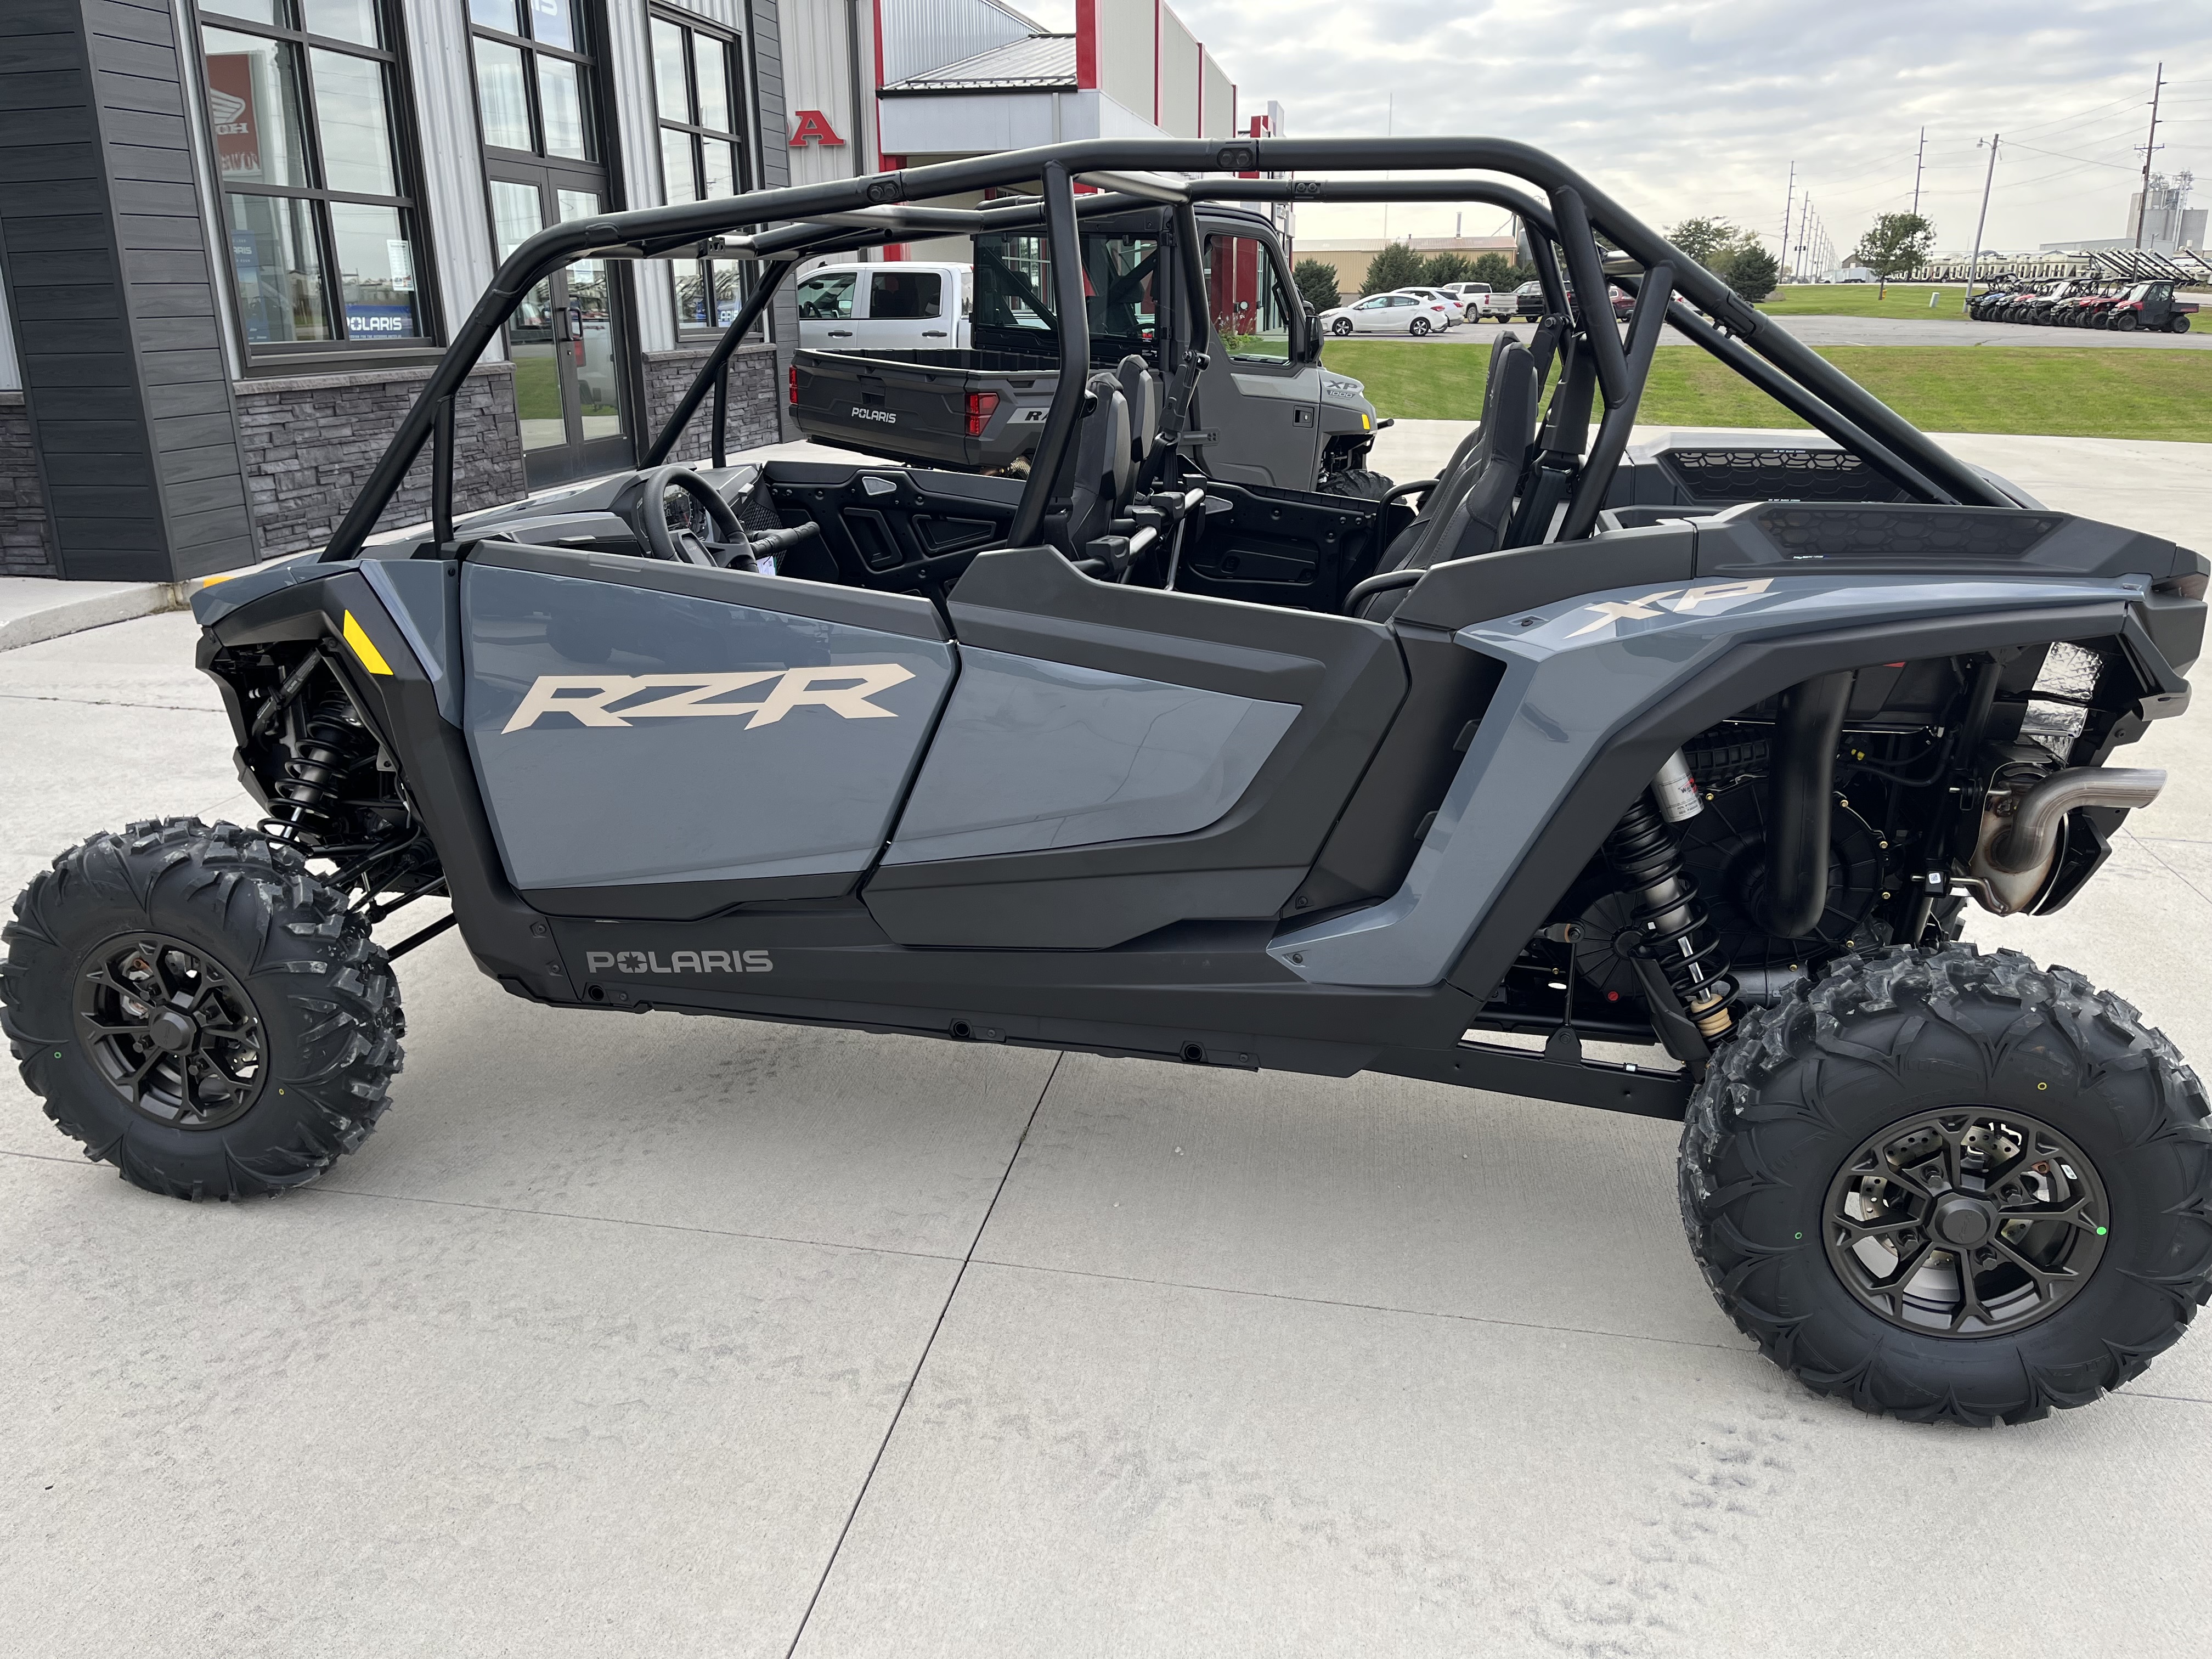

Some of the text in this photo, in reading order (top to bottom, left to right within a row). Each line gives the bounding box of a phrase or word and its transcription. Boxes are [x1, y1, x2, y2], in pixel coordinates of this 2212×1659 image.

[788, 110, 845, 146] A
[1327, 380, 1358, 390] XP
[851, 407, 896, 424] POLARIS
[1563, 578, 1775, 640] XP
[500, 663, 916, 735] RZR
[586, 950, 774, 973] POLARIS
